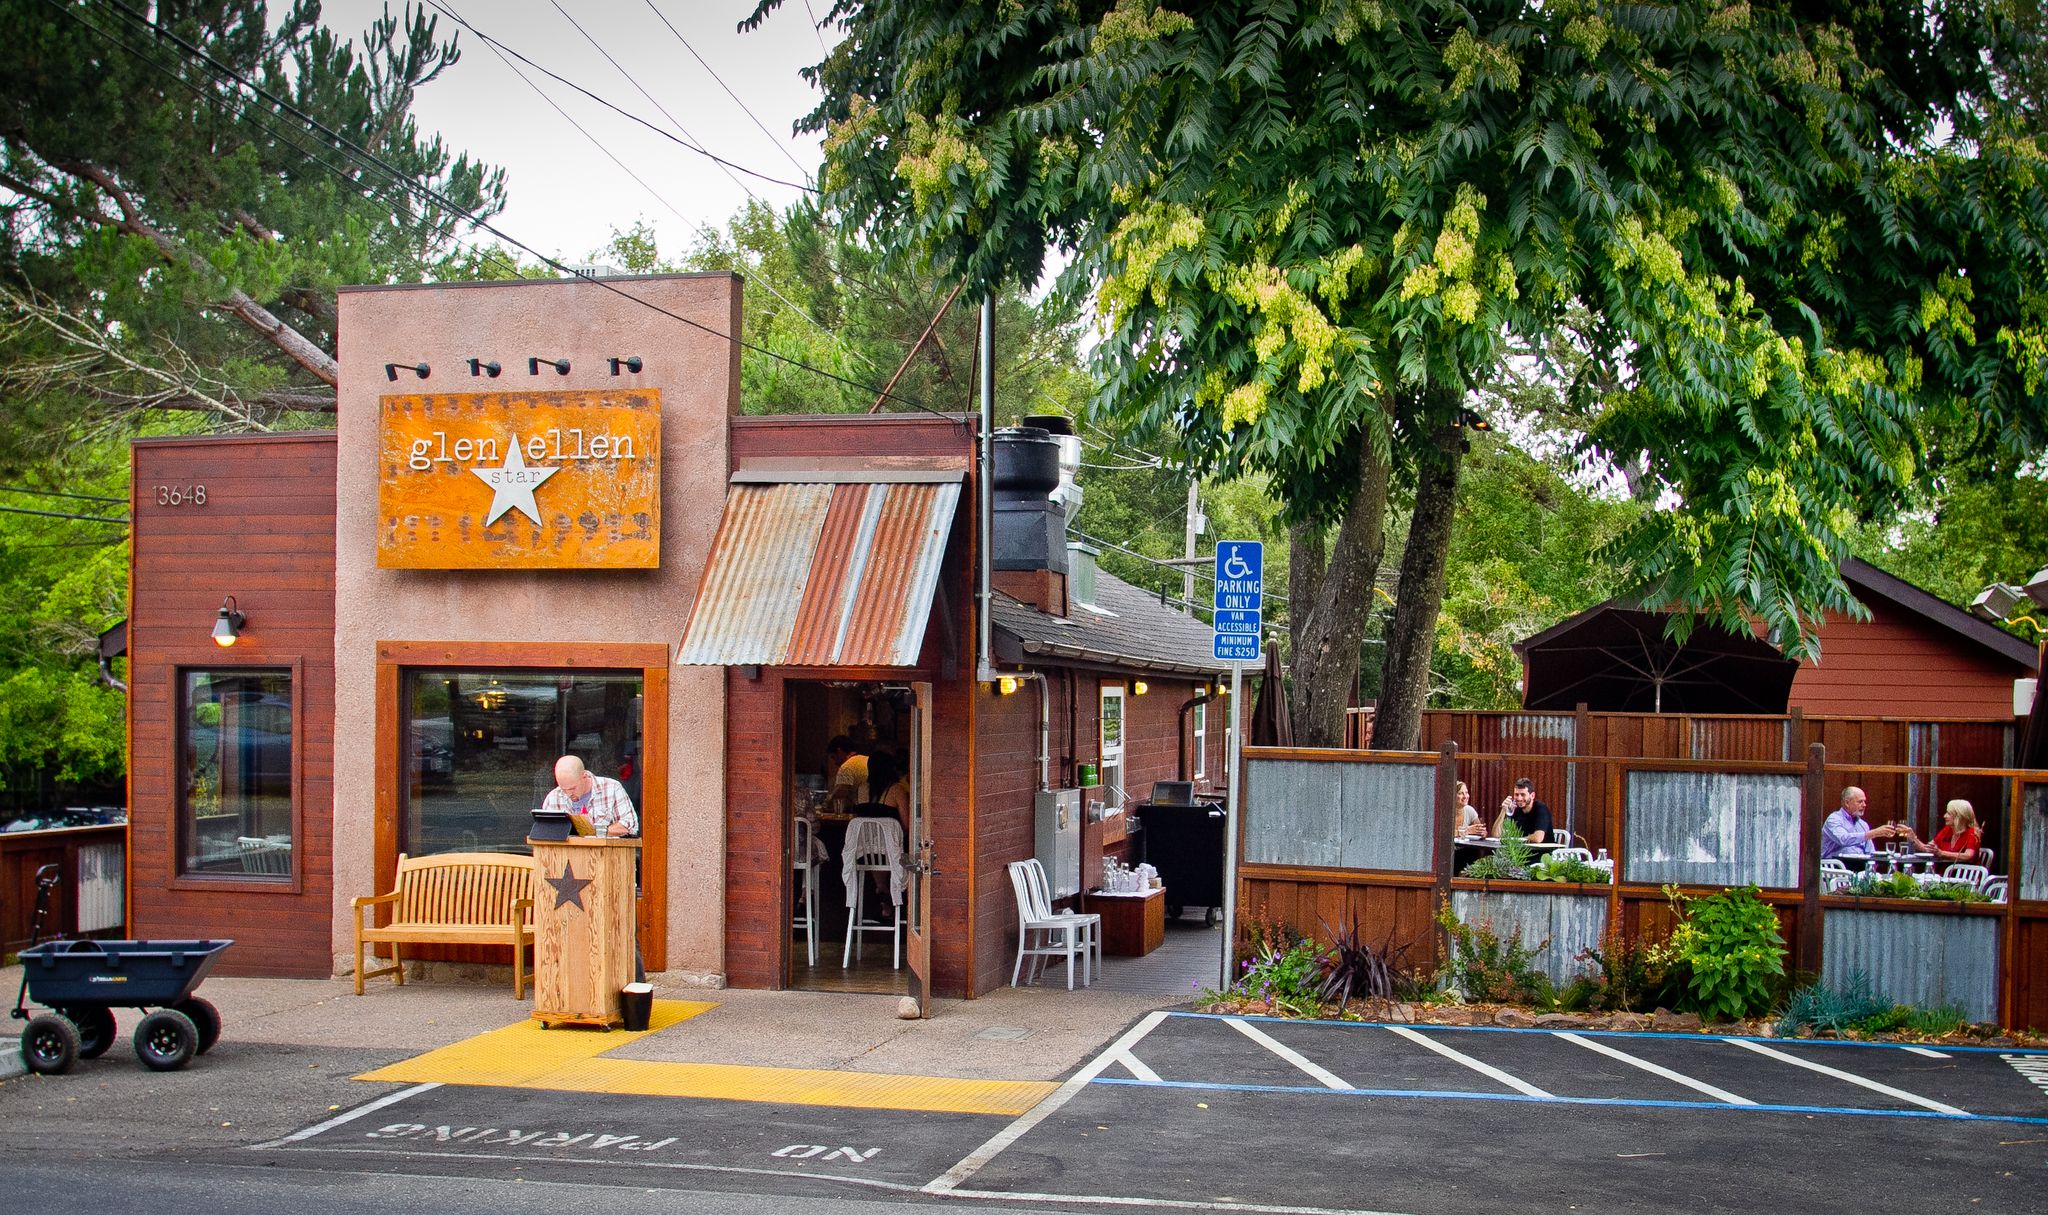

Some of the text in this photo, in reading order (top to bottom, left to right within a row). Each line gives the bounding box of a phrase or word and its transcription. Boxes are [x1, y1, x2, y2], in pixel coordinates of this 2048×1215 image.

[408, 429, 636, 471] glen ellen
[491, 468, 541, 484] star
[152, 484, 207, 505] 13648
[1217, 580, 1260, 594] PARKING
[1225, 595, 1251, 608] ONLY
[1231, 611, 1244, 620] VAN
[1217, 623, 1257, 632] ACCESSIBLE
[1221, 636, 1252, 646] MINIMUM
[1217, 647, 1255, 657] FINE $250
[366, 1123, 883, 1163] NO PARKING
